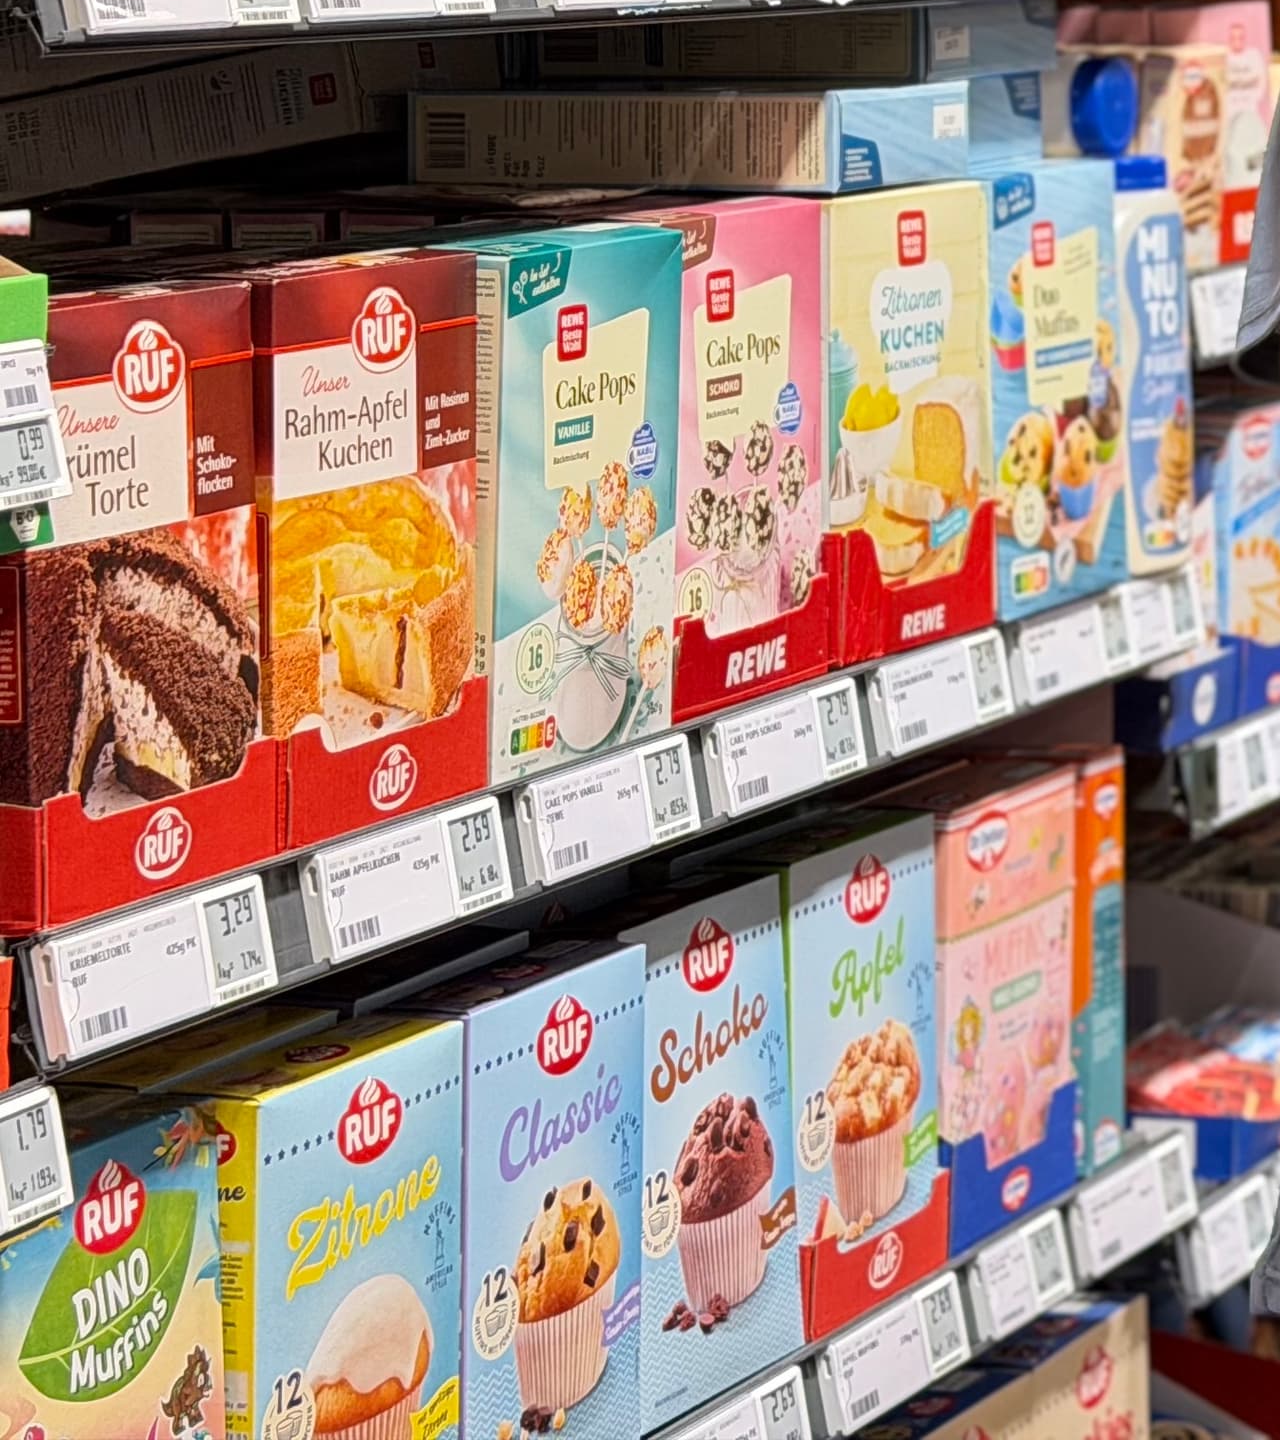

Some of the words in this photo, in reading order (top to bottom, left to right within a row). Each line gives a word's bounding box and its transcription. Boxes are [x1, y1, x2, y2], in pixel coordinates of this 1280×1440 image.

[1137, 225, 1169, 261] MI
[709, 277, 731, 291] REWE
[1141, 262, 1178, 301] NU
[560, 313, 585, 327] REWE
[881, 285, 942, 319] Zitronen
[1145, 302, 1179, 337] TO
[360, 313, 406, 353] RUF
[562, 329, 582, 342] Beste
[563, 339, 582, 353] Wahl
[705, 339, 743, 368] Cake
[746, 332, 781, 365] Pops
[880, 320, 944, 354] KUCHEN
[124, 349, 174, 395] RUF
[301, 365, 350, 397] Unser
[709, 379, 740, 396] SCHOKO
[425, 394, 439, 412] Mit
[441, 391, 470, 408] Rosinen
[556, 375, 596, 409] Cake
[599, 372, 636, 408] Pops
[57, 405, 119, 437] Unsere
[284, 389, 408, 440] Rahm-Apfel
[425, 413, 441, 430] und
[557, 420, 592, 441] VANILLE
[197, 435, 215, 453] Mit
[318, 435, 393, 472] Kuchen
[425, 428, 471, 452] Zimt-Zucker
[67, 435, 136, 482] rümel
[197, 450, 237, 475] Schoko-
[86, 480, 150, 517] Torte
[198, 475, 233, 496] flocken
[901, 603, 947, 639] REWE
[527, 645, 543, 671] 16
[725, 634, 787, 688] REWE
[827, 697, 849, 726] 2.79
[376, 763, 411, 800] RUF
[655, 751, 681, 786] 2.79
[545, 796, 561, 809] CAKE
[562, 789, 579, 804] POPS
[580, 782, 603, 799] VANILLE
[143, 827, 184, 860] RUF
[461, 814, 491, 853] 2.69
[330, 868, 351, 883] RAHM
[353, 852, 401, 876] APFELKUCHEN
[849, 873, 887, 916] RUF
[219, 894, 253, 936] 3.29
[70, 942, 132, 971] KRUEMELTORTE
[688, 939, 729, 983] RUF
[829, 914, 905, 1019] Apfel
[542, 1019, 590, 1066] RUF
[650, 982, 769, 1104] Schoko
[804, 1087, 827, 1112] 12
[16, 1108, 49, 1152] 1.79
[345, 1102, 398, 1156] RUF
[499, 1063, 624, 1183] Classic
[644, 1171, 670, 1209] 12
[83, 1181, 140, 1246] RUF
[285, 1155, 442, 1302] Zitrone
[869, 1247, 898, 1282] RUF
[72, 1246, 150, 1340] DINO
[483, 1268, 508, 1308] 12
[69, 1289, 168, 1394] Muffins
[273, 1371, 302, 1415] 12
[771, 1385, 795, 1423] 2.69
